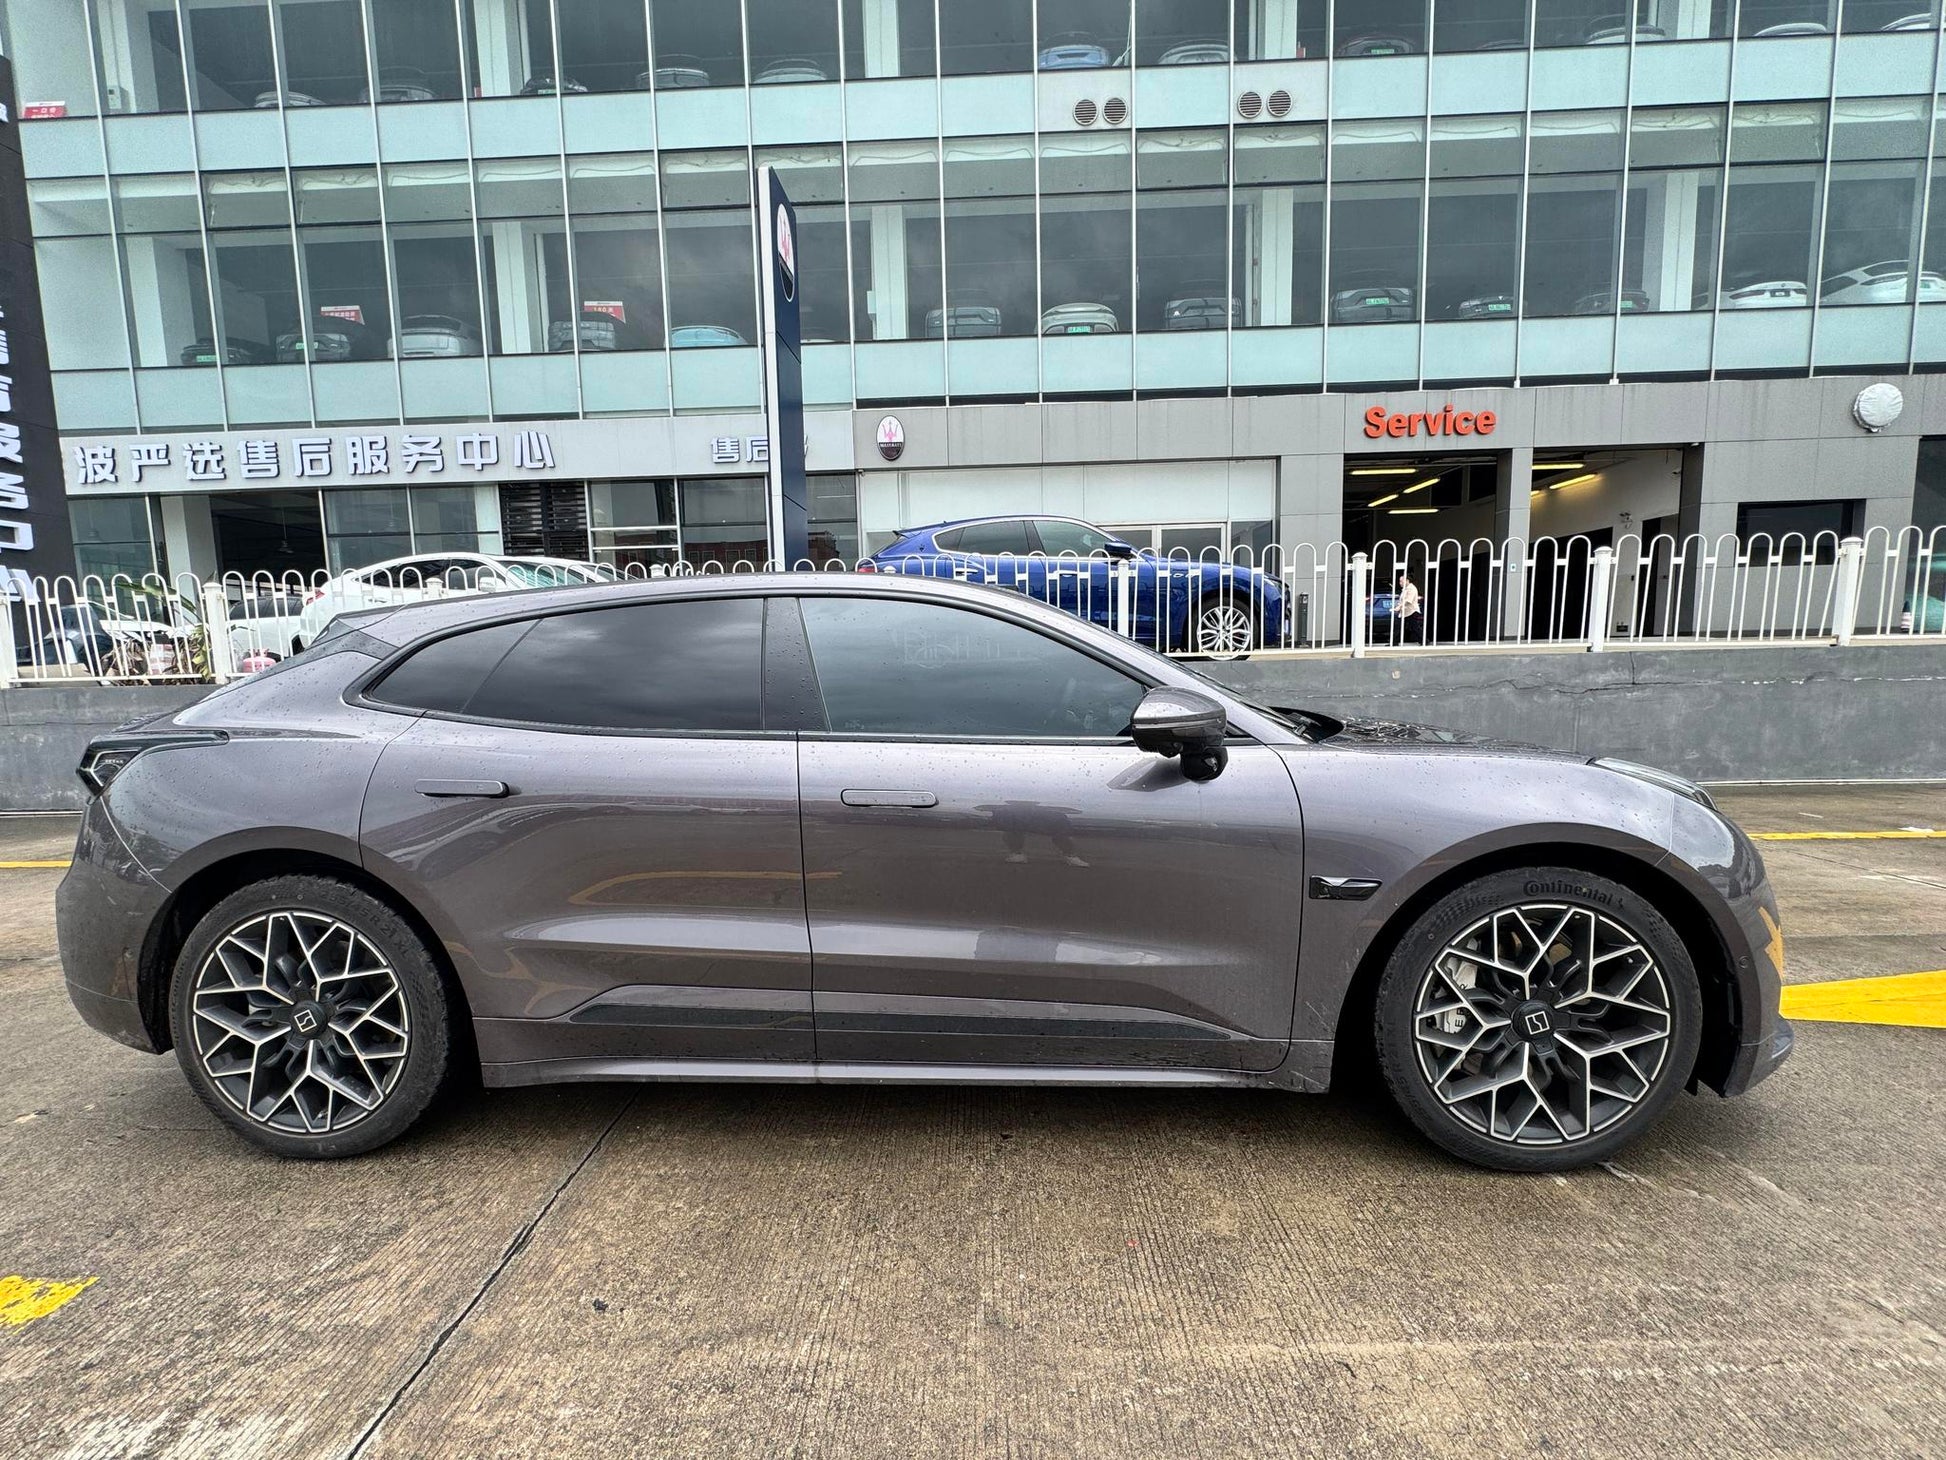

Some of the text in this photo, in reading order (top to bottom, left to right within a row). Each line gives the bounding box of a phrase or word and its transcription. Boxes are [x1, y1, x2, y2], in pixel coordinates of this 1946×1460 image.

[1364, 404, 1497, 438] Service
[73, 430, 556, 485] 波严选售后服务中心
[711, 435, 809, 464] 售后
[1523, 880, 1613, 906] Continental
